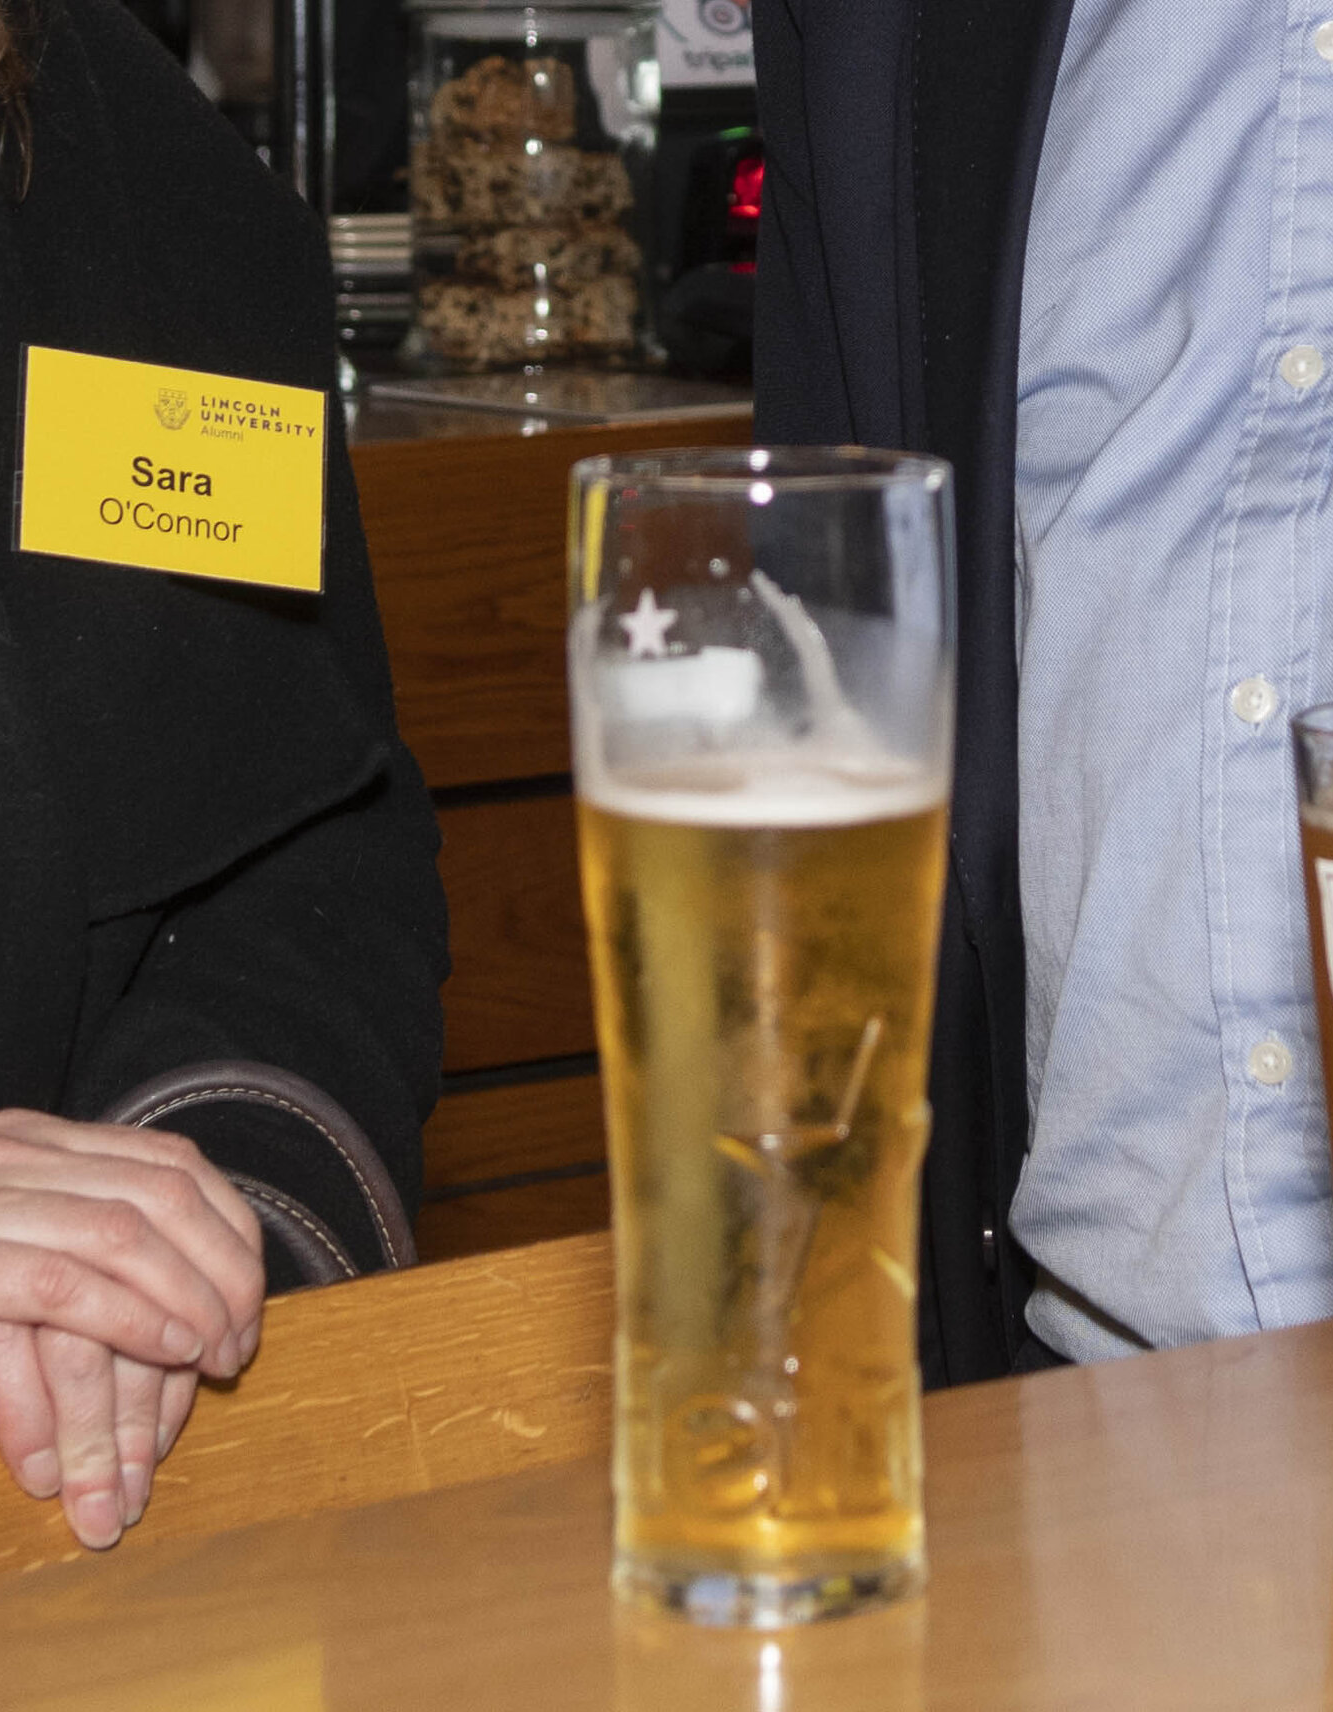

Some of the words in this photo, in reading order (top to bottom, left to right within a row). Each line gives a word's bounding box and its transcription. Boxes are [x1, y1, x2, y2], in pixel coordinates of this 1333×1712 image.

[201, 395, 281, 418] LINCOLN
[201, 410, 317, 438] UNIVERSITY
[201, 425, 245, 442] Alumni
[131, 456, 213, 497] Sara
[99, 497, 243, 543] O'Connor
